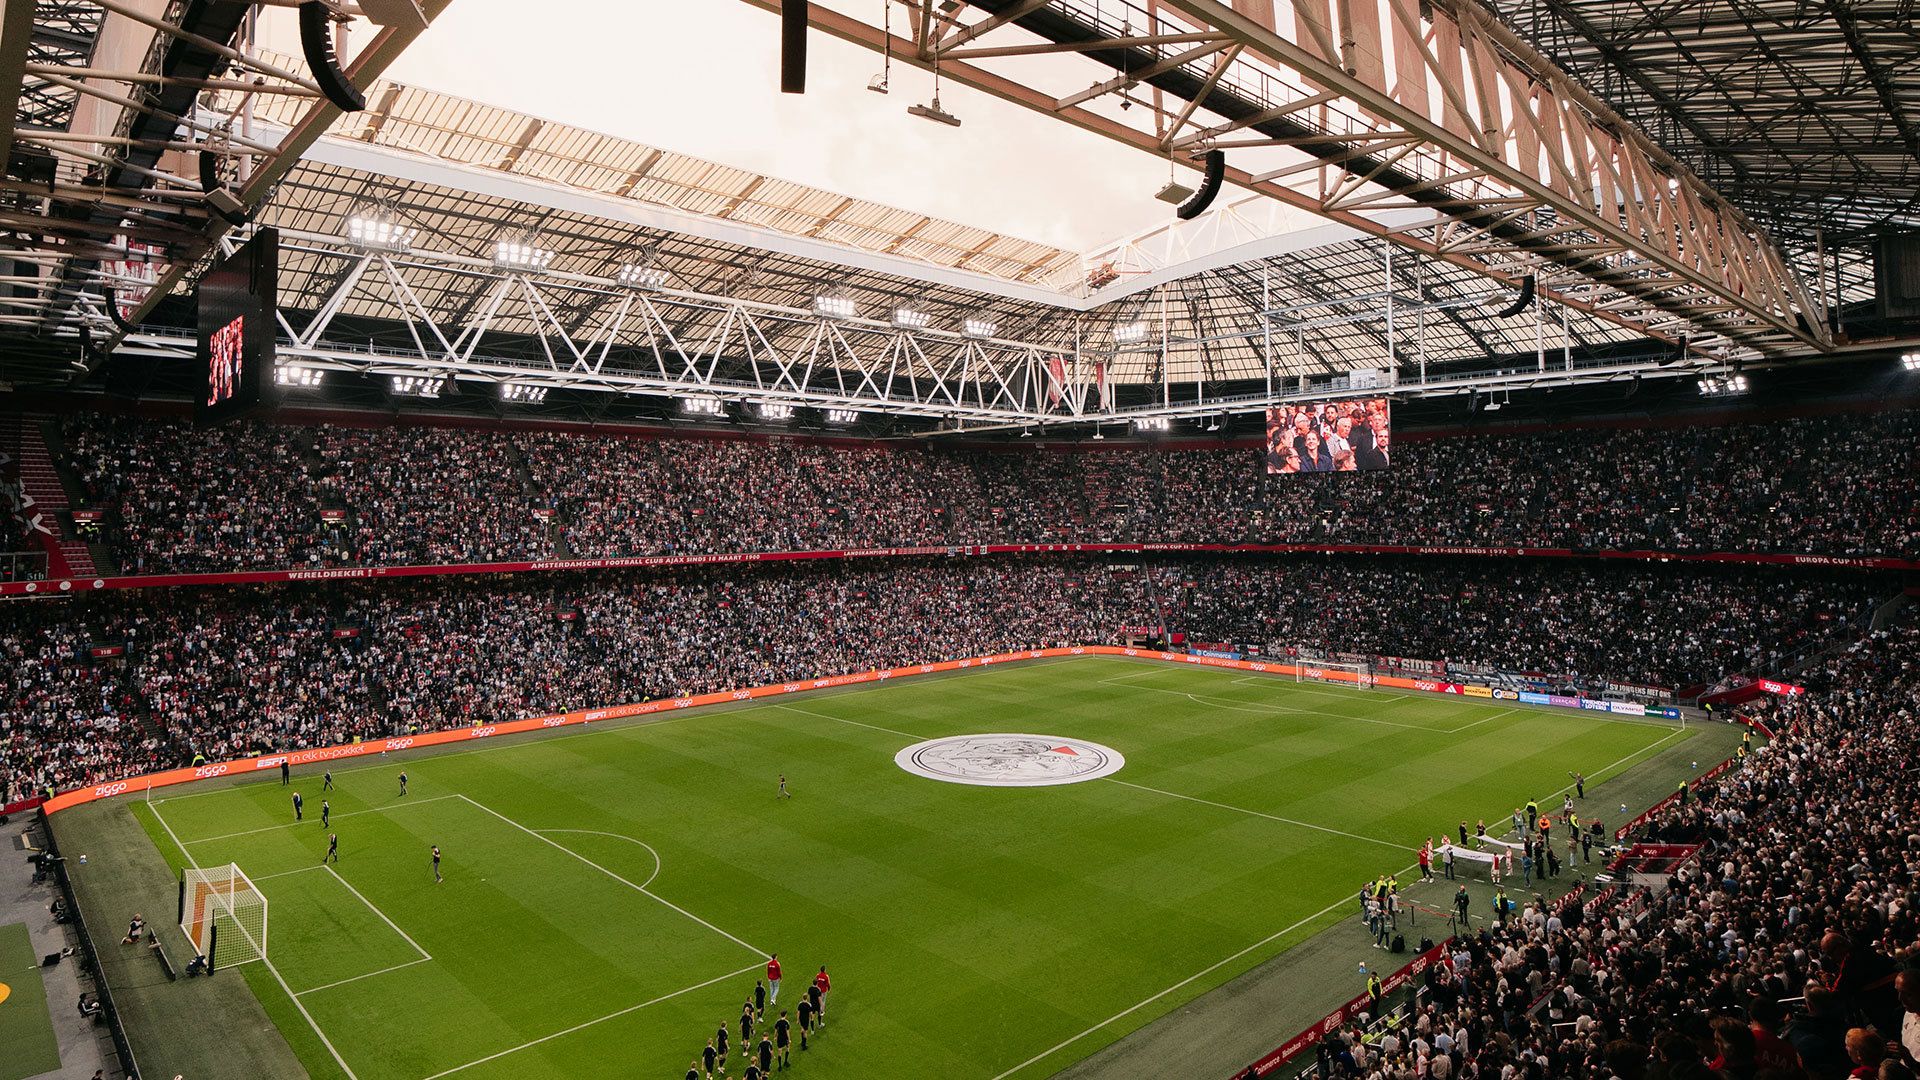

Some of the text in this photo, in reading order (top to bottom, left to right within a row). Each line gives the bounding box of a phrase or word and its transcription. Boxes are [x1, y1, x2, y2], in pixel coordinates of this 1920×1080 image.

[843, 549, 889, 557] LANDSKAMPIOEN
[531, 560, 601, 569] AMSTERDAMSCHE
[605, 558, 643, 566] FOOTBALL
[1795, 556, 1829, 564] EUROPA
[1832, 557, 1850, 565] CUP
[288, 569, 364, 579] WERELDBEKER
[1305, 668, 1323, 677] ziggo
[784, 683, 800, 692] ziggo
[1414, 681, 1436, 691] ziggo
[1764, 681, 1782, 693] ziggo
[733, 690, 750, 699] ziggo
[674, 699, 693, 708] ziggo
[542, 716, 566, 727] ziggo
[471, 725, 496, 738] ziggo
[386, 737, 414, 750] ziggo
[291, 753, 300, 763] in
[302, 751, 317, 761] elk
[319, 743, 366, 759] tv-pakket
[195, 763, 227, 778] ziggo
[95, 781, 127, 797] ziggo
